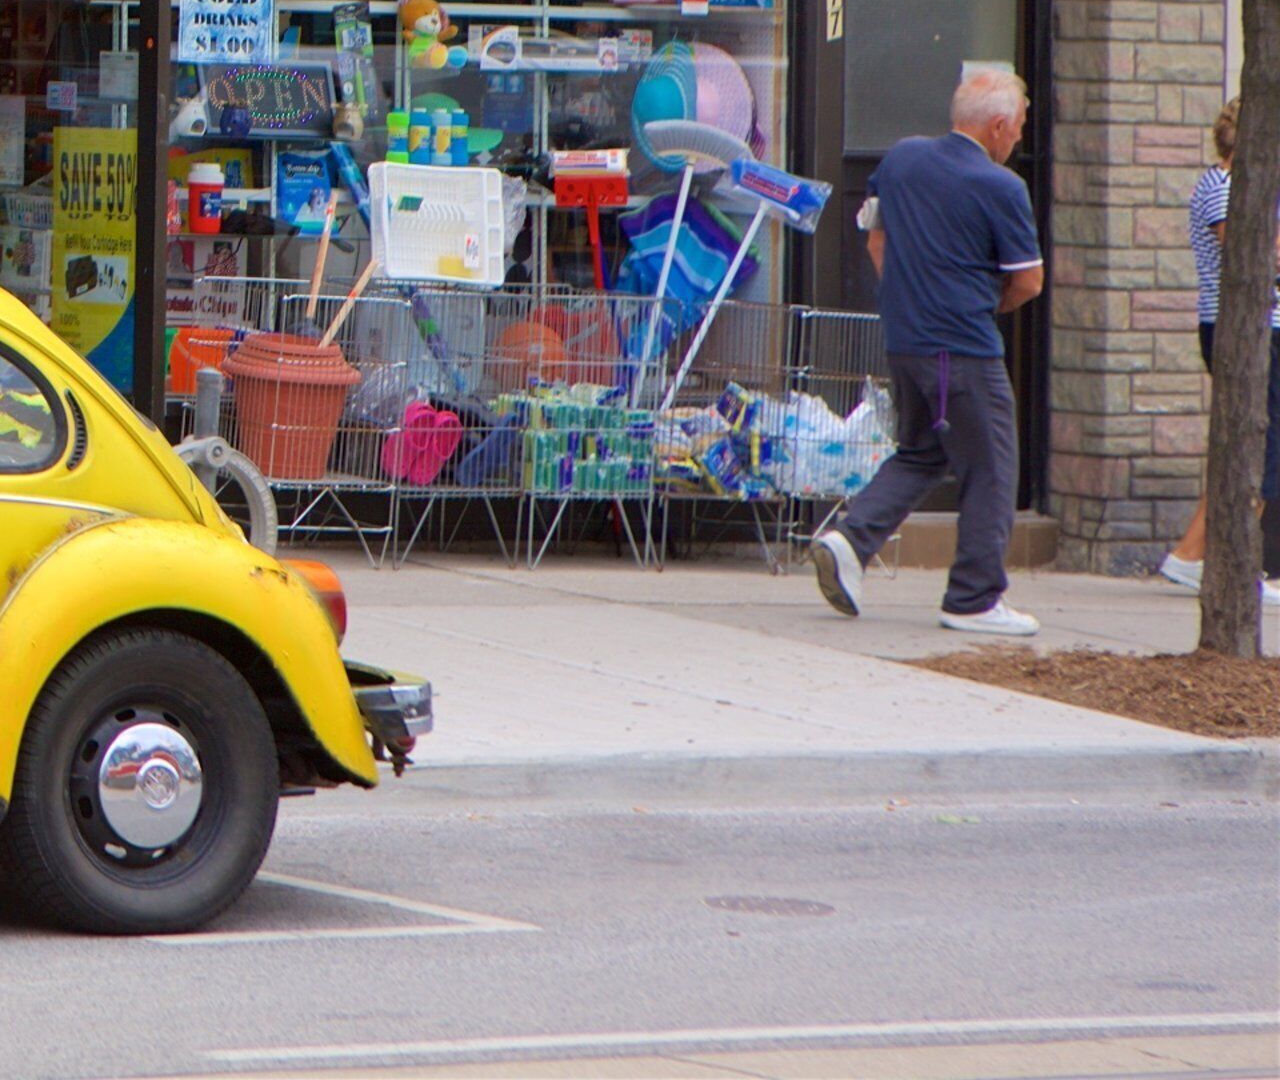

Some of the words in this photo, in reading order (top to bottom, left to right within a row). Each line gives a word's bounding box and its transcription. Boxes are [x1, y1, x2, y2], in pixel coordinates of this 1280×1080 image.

[194, 12, 259, 27] DRINKS
[196, 34, 256, 54] $1.00
[209, 76, 328, 113] OPEN
[60, 151, 102, 212] SAVE
